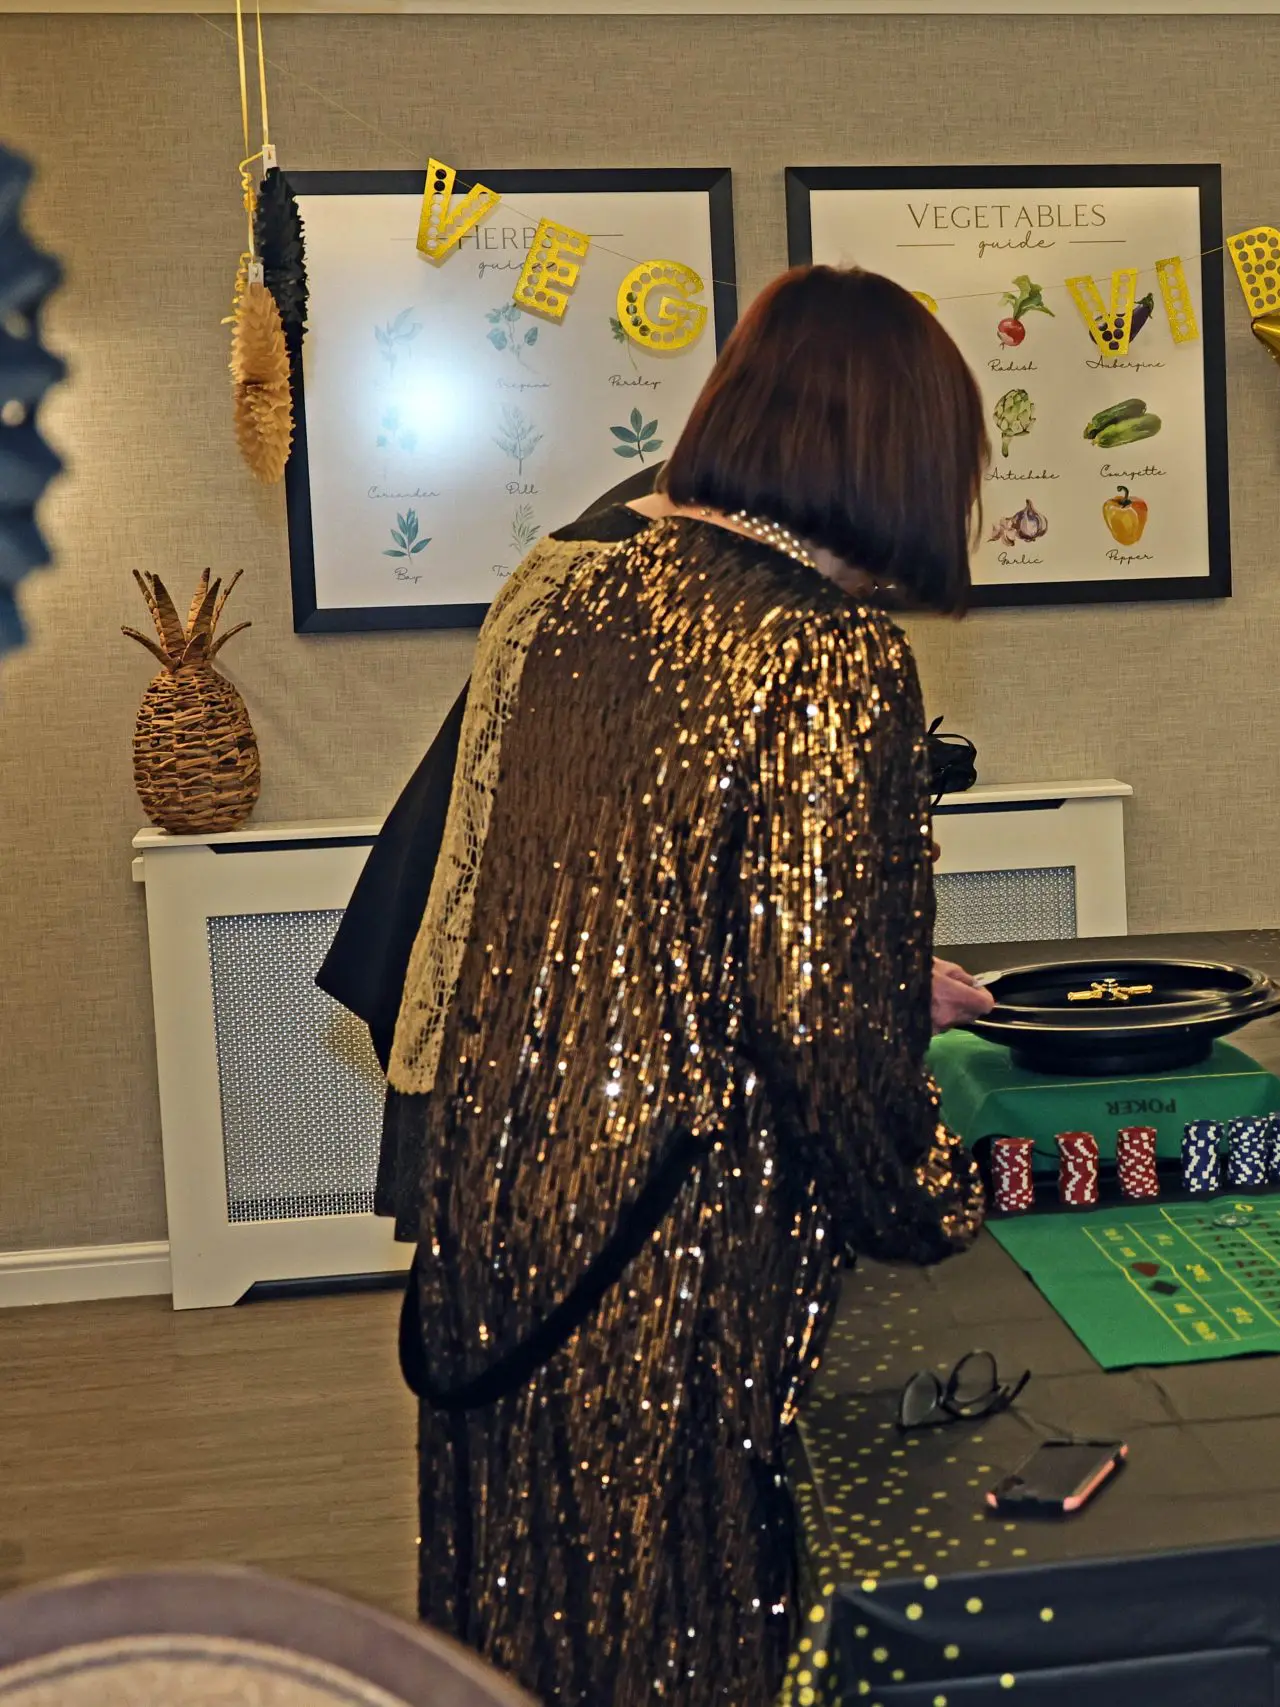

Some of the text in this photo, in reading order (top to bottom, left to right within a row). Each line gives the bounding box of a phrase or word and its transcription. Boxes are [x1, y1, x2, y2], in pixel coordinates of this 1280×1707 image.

[907, 203, 1107, 230] VEGETABLES
[457, 224, 553, 250] HERB
[978, 230, 1056, 258] guide
[987, 358, 1038, 373] Radish
[1085, 355, 1166, 373] Aubergine
[608, 374, 662, 390] Parsley
[984, 467, 1061, 481] Artichoke
[1099, 463, 1167, 481] Courgette
[367, 485, 442, 500] Coriander
[505, 481, 540, 496] Dill
[997, 551, 1044, 566] Garlic
[1105, 548, 1154, 565] Pepper
[393, 567, 423, 584] Bay
[1105, 1098, 1177, 1116] POKER
